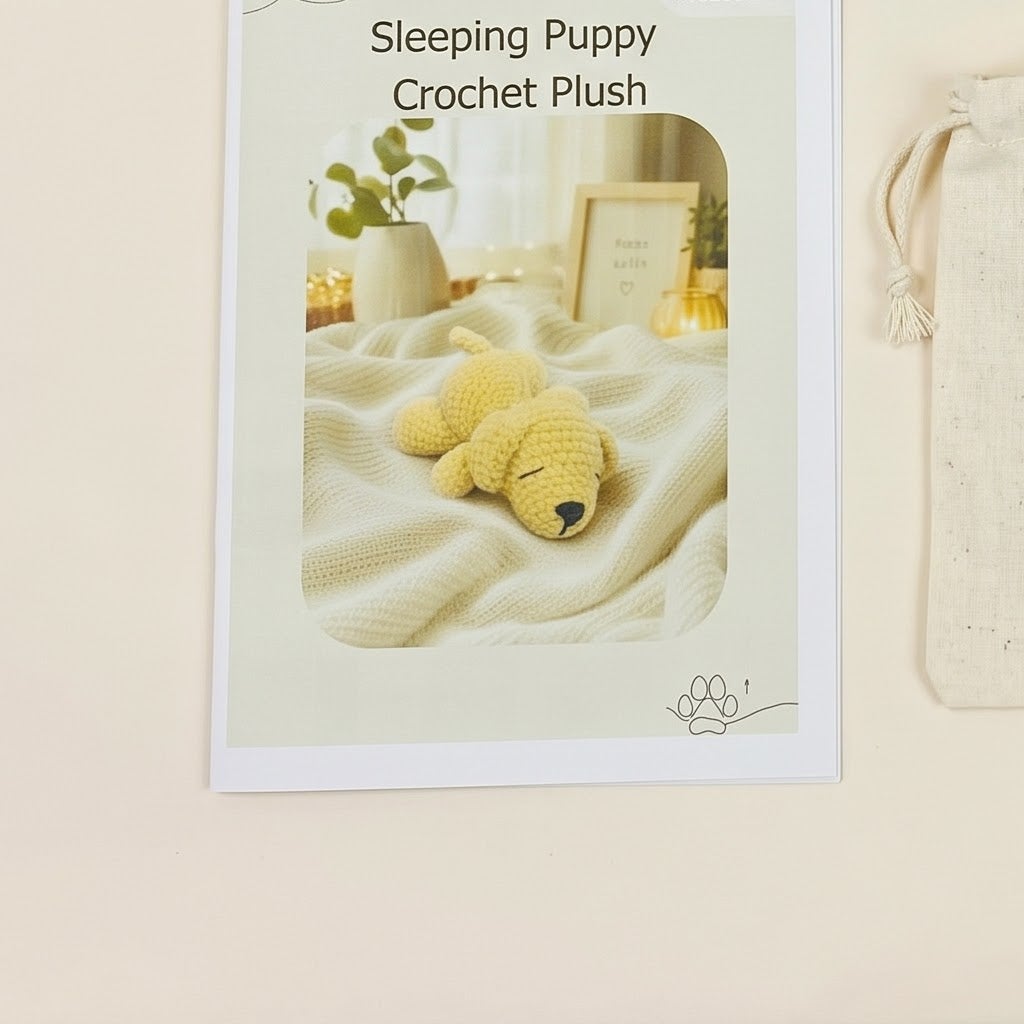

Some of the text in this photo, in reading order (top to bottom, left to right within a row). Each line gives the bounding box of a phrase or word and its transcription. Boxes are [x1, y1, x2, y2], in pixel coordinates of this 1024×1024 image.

[371, 18, 657, 60] Sleeping Puppy
[393, 73, 647, 111] Crochet Plush
